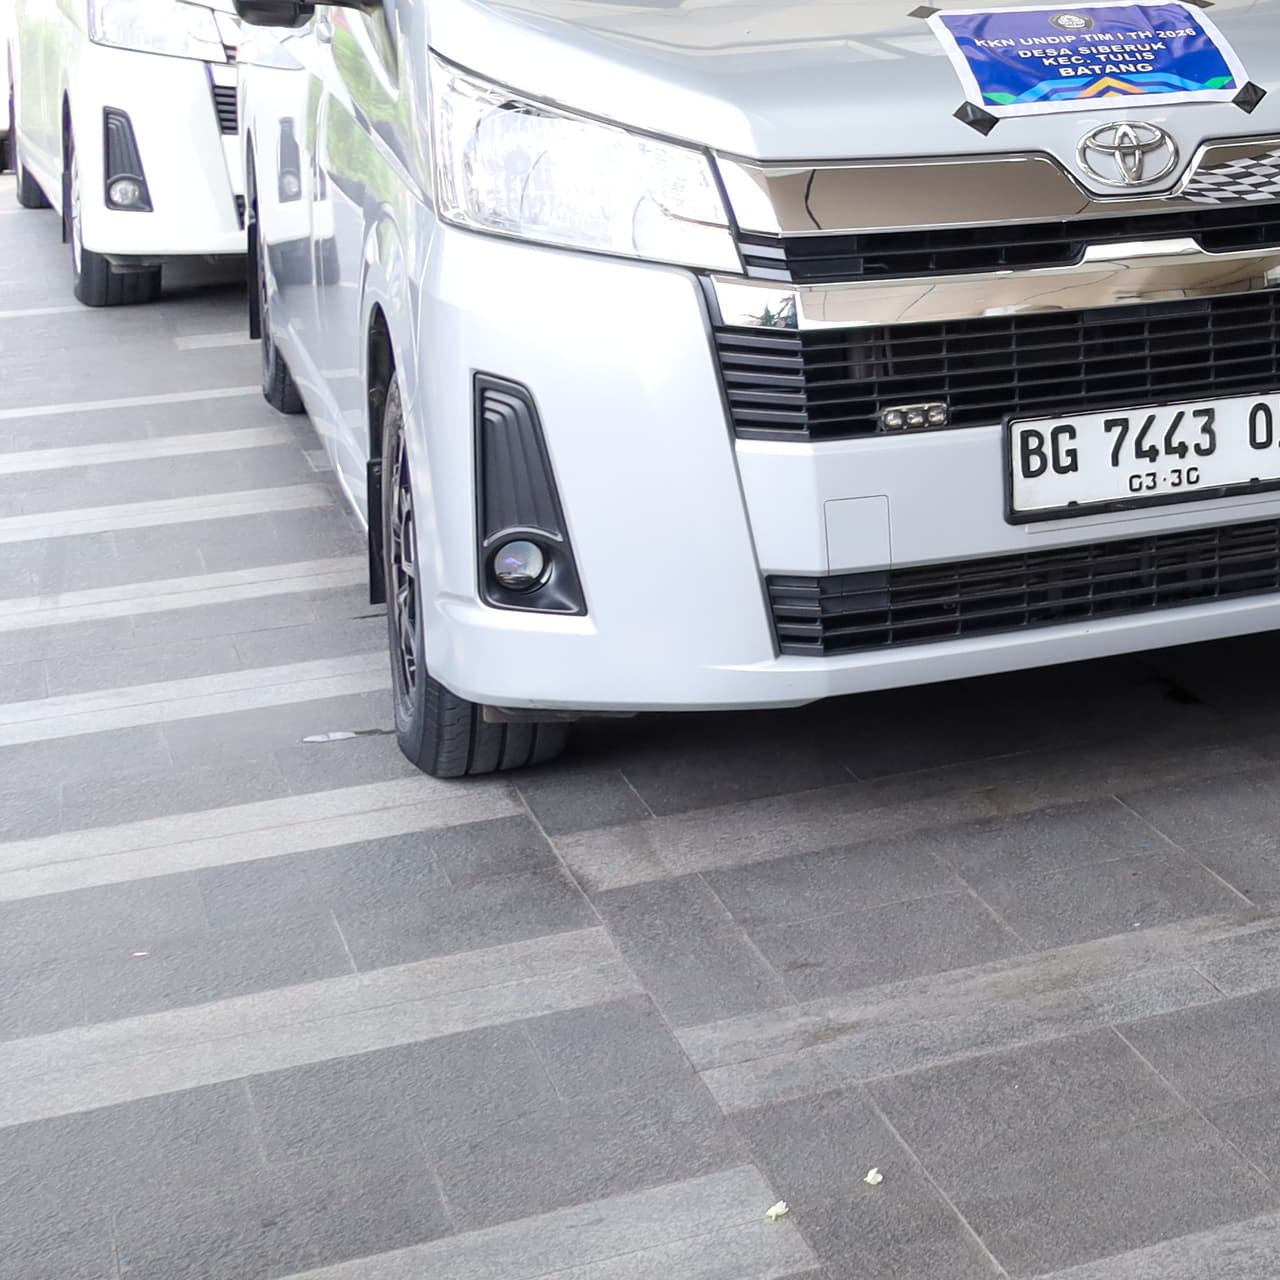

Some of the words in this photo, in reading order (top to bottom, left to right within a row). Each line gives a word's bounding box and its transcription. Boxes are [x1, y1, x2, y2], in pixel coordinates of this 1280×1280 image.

[974, 38, 1016, 48] KKN
[1019, 35, 1077, 46] UNDIP
[1081, 32, 1115, 42] TIM
[1127, 30, 1153, 40] TH
[1156, 27, 1197, 38] 2026
[1017, 48, 1073, 58] DESA
[1078, 42, 1167, 55] SIBERUK
[1042, 55, 1091, 66] KEC.
[1096, 51, 1155, 63] TULIS
[1058, 63, 1153, 77] BATANG
[1019, 424, 1079, 479] BG
[1104, 408, 1217, 467] 7443
